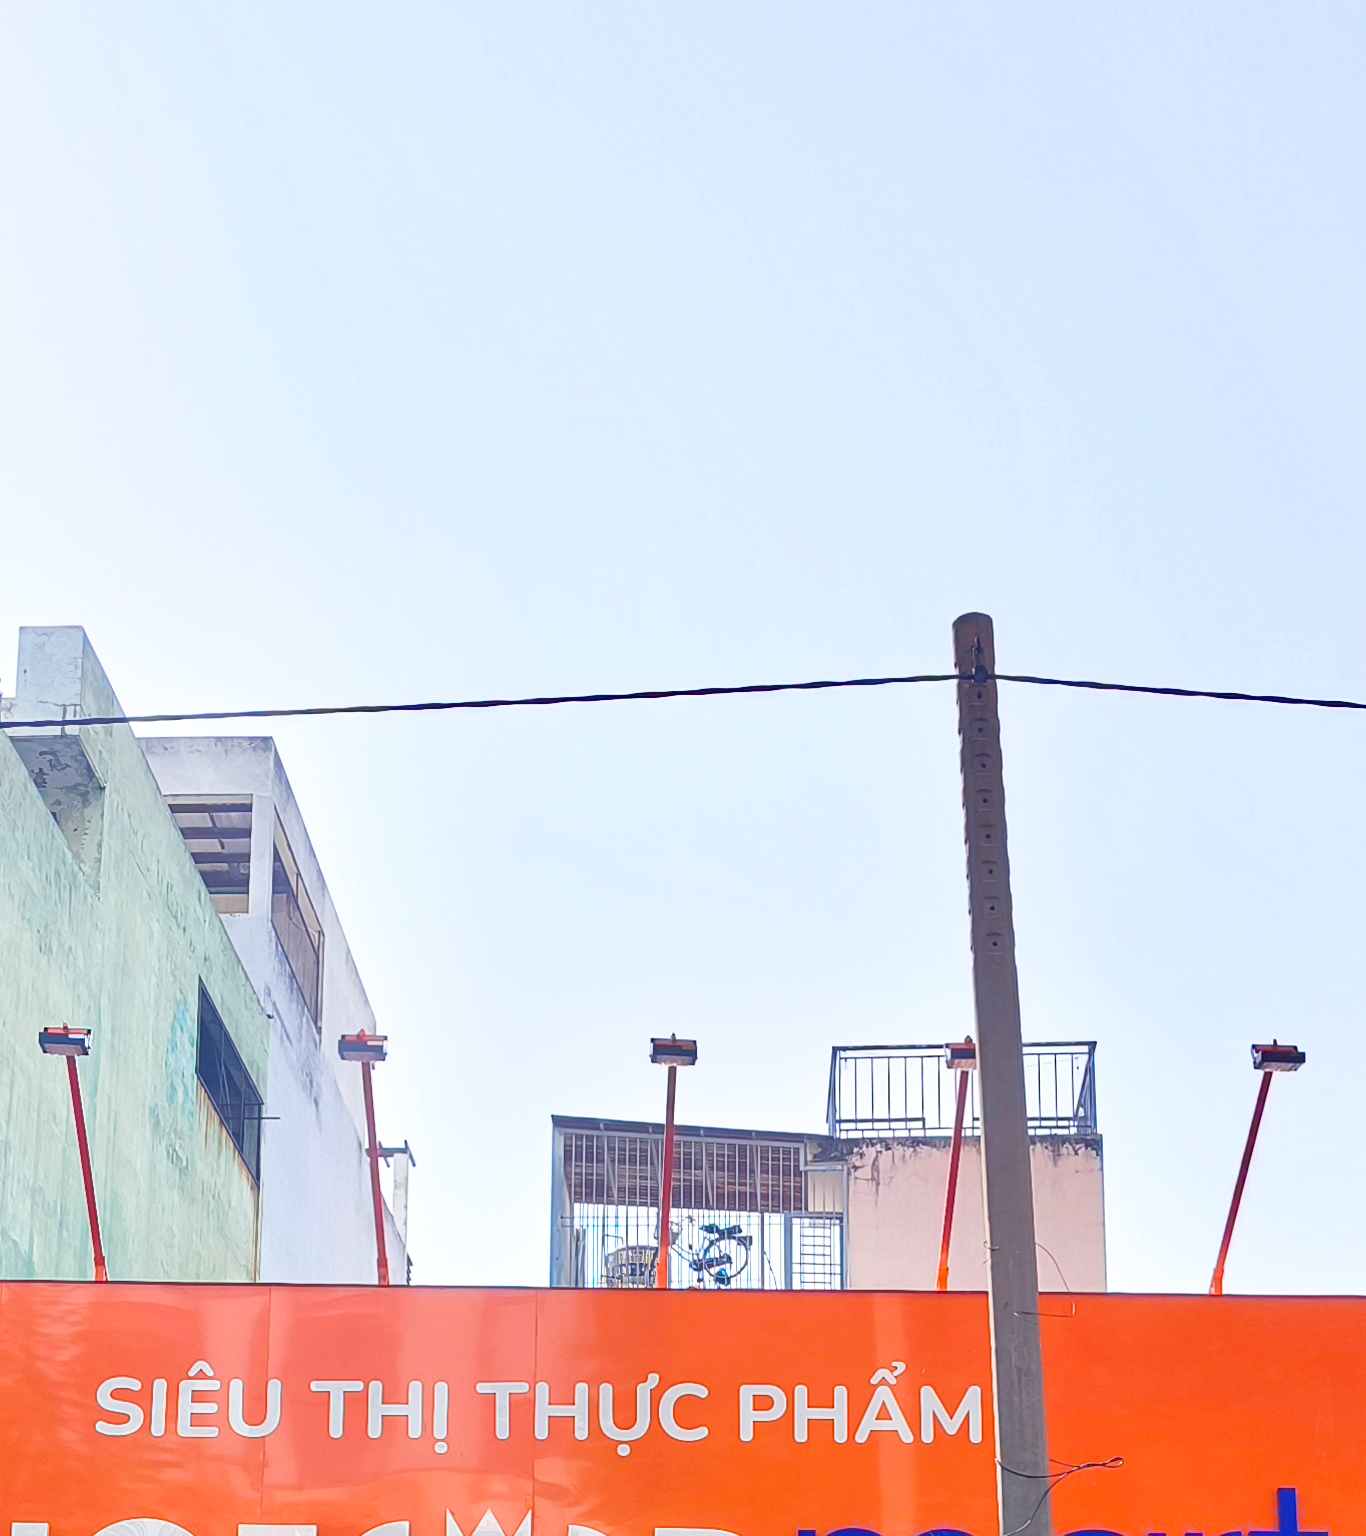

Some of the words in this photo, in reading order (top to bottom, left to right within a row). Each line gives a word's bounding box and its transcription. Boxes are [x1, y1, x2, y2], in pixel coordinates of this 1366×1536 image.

[95, 1361, 282, 1440] SIÊU
[310, 1379, 449, 1455] THỊ
[475, 1373, 709, 1457] THỰC
[739, 1361, 984, 1445] PHẨM
